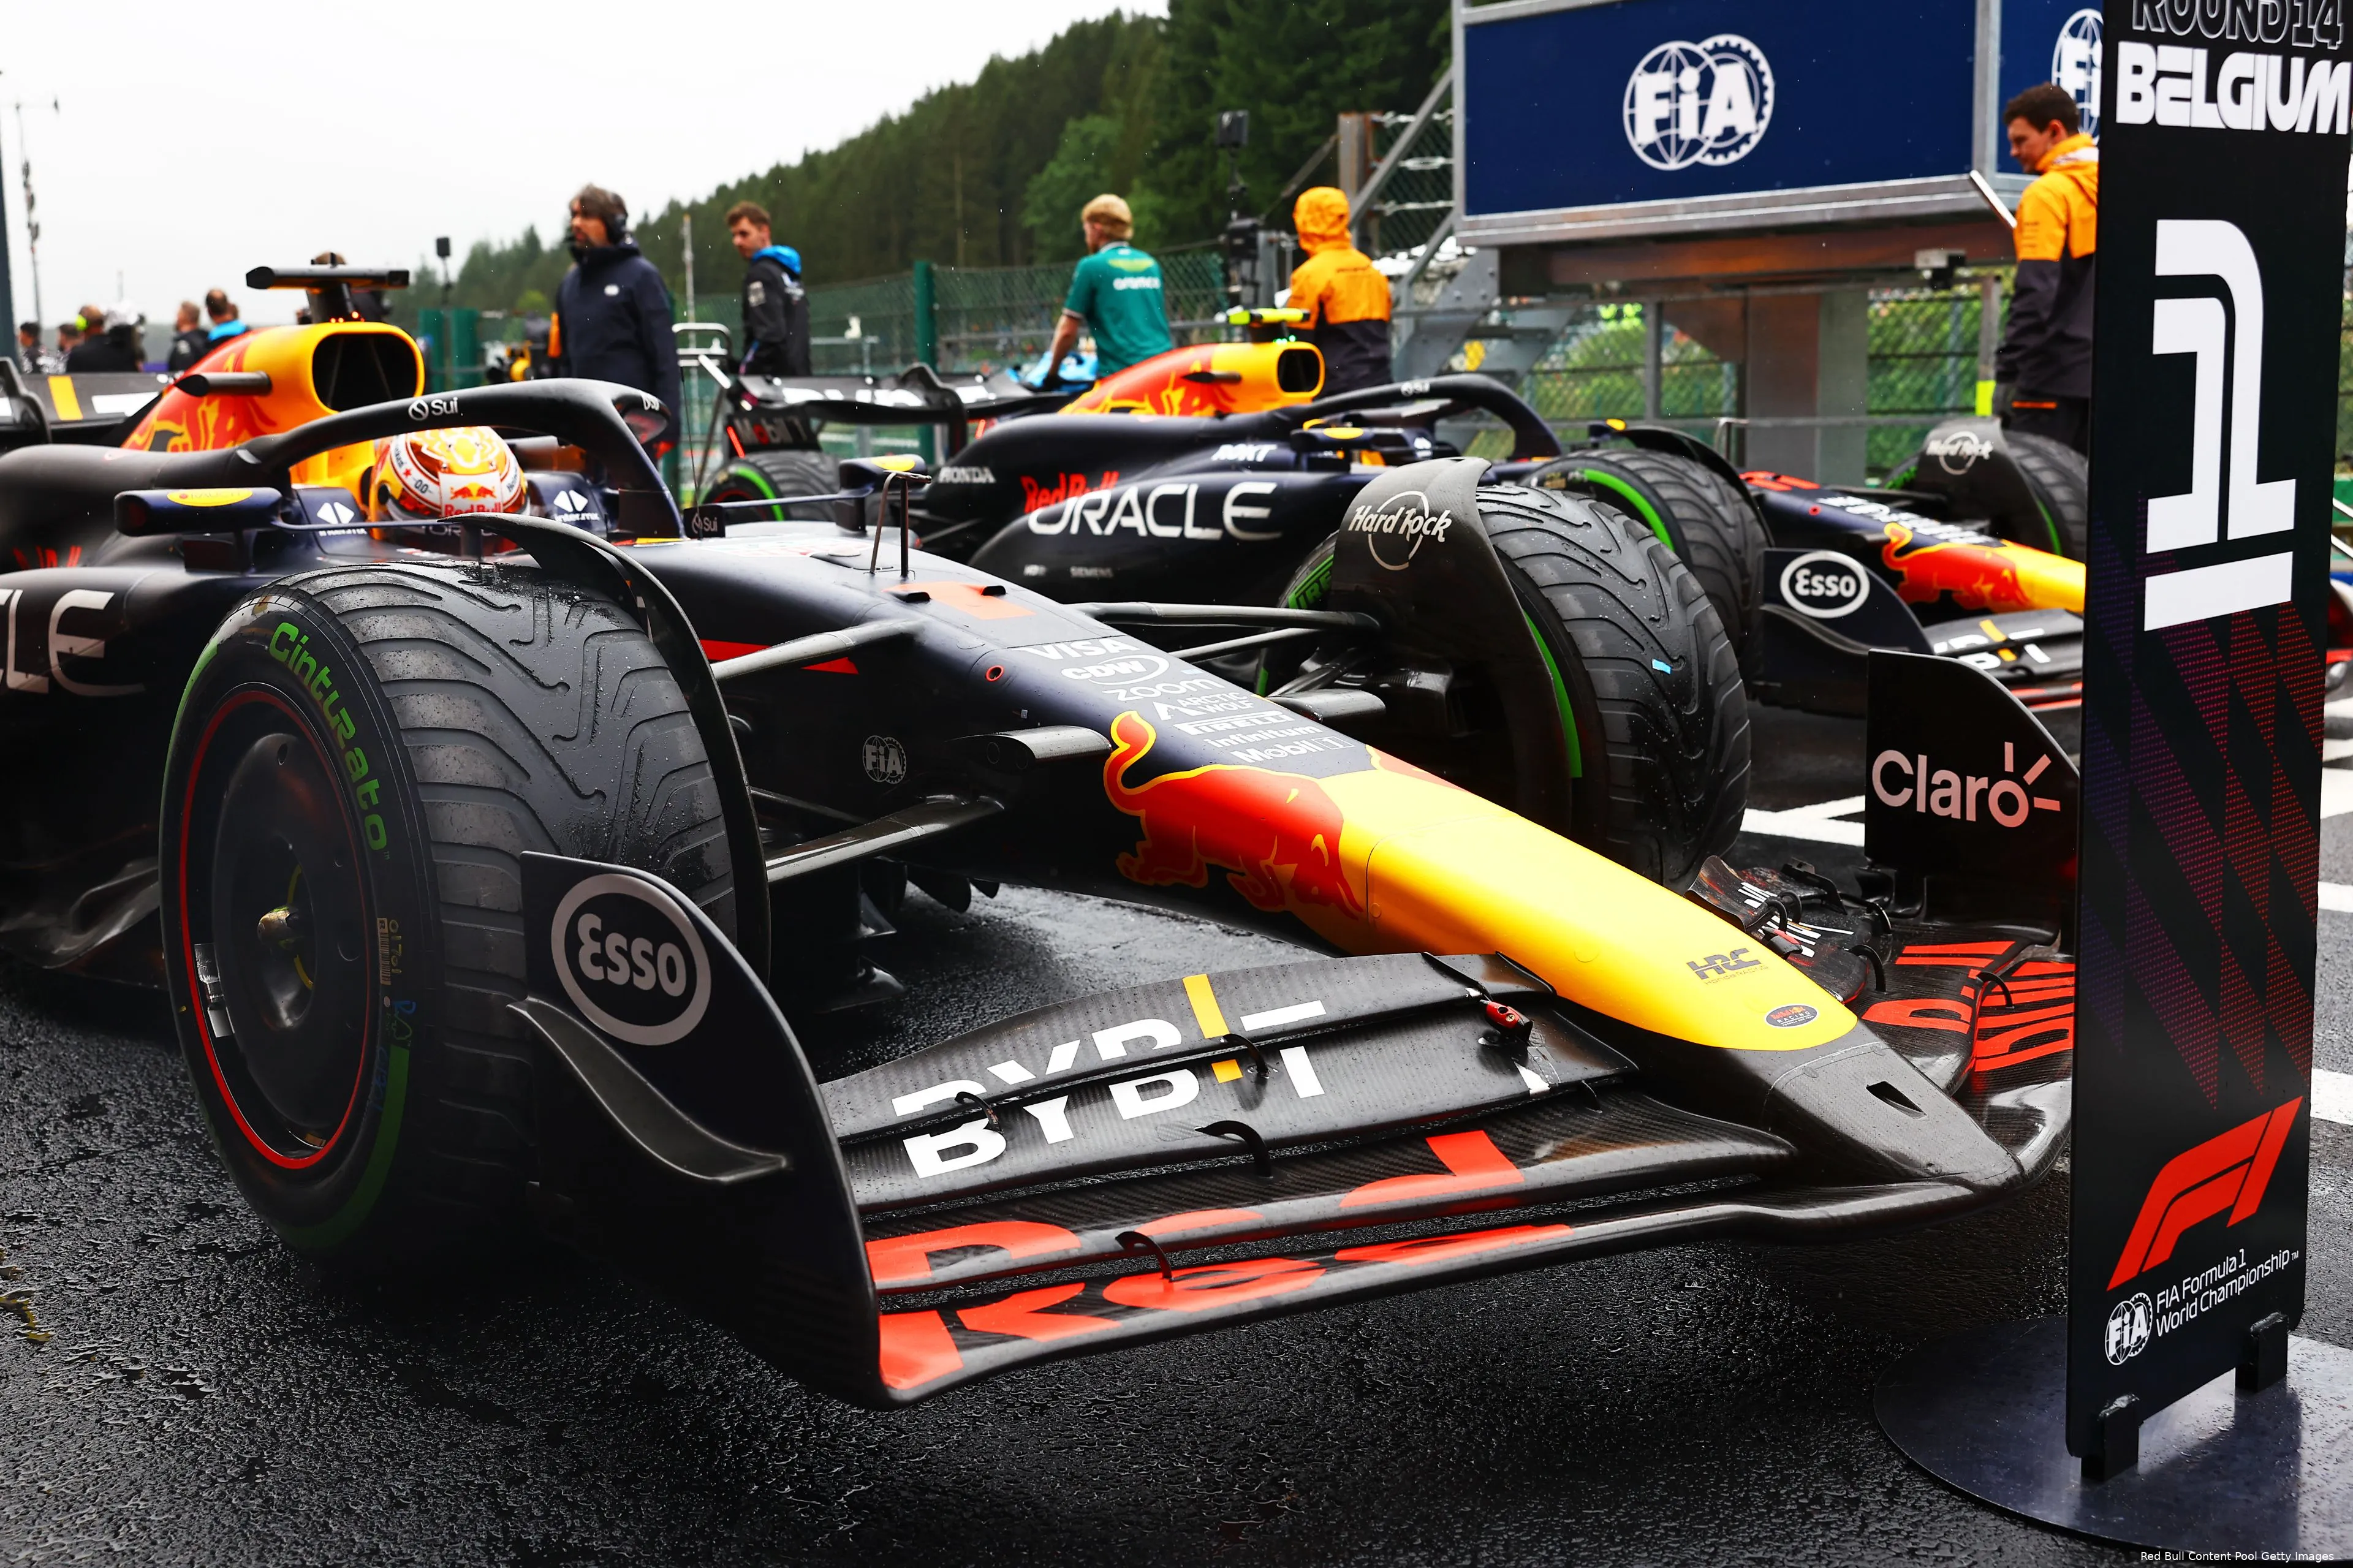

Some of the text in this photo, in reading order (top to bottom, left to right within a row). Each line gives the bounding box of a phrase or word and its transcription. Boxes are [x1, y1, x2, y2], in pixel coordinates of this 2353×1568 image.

[2116, 40, 2352, 135] BELGIUM
[2145, 219, 2297, 554] 1
[431, 397, 458, 415] Sui
[938, 466, 996, 483] HONDA
[703, 517, 718, 532] Sui
[1028, 482, 1283, 541] ORACLE
[1348, 505, 1452, 542] Hard Rock
[1795, 568, 1857, 599] Esso
[1012, 638, 1141, 661] VISA
[1061, 660, 1148, 680] CDW
[1176, 692, 1249, 707] ARCTIC
[1197, 700, 1254, 713] WOLF
[269, 622, 387, 851] Cinturato
[1173, 710, 1295, 735] PIRELLI
[1203, 725, 1323, 748] infinitum
[1230, 740, 1325, 763] Mobil
[1872, 749, 2029, 828] Claro
[577, 913, 688, 998] Esso
[891, 973, 1327, 1179] BYBIT
[2156, 1248, 2246, 1314] FIA Formula 1
[2156, 1297, 2197, 1337] World
[2200, 1249, 2289, 1312] Championship
